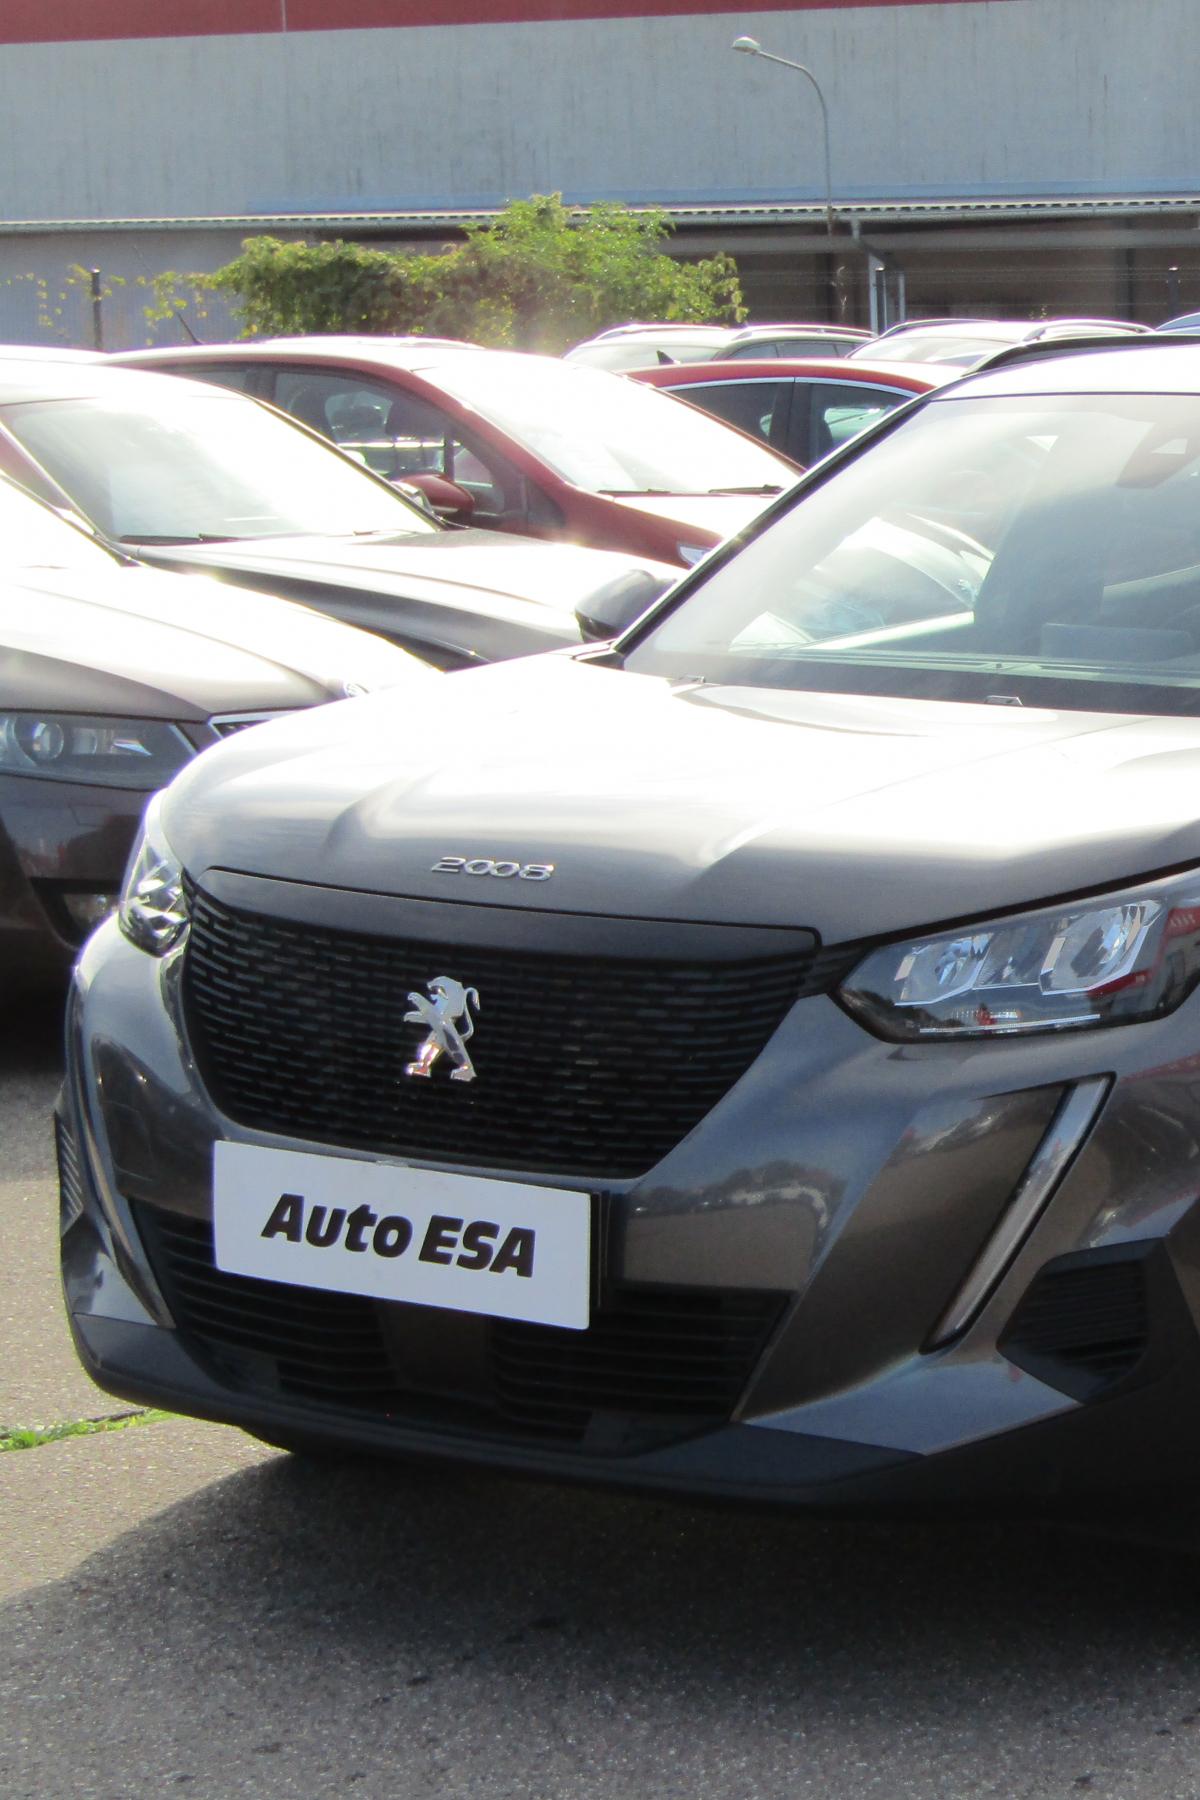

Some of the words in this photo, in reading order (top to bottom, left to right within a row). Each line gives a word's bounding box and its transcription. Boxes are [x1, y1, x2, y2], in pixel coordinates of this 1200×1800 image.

[431, 856, 554, 881] 2008
[260, 1192, 414, 1258] Auto
[418, 1214, 536, 1278] ESA
